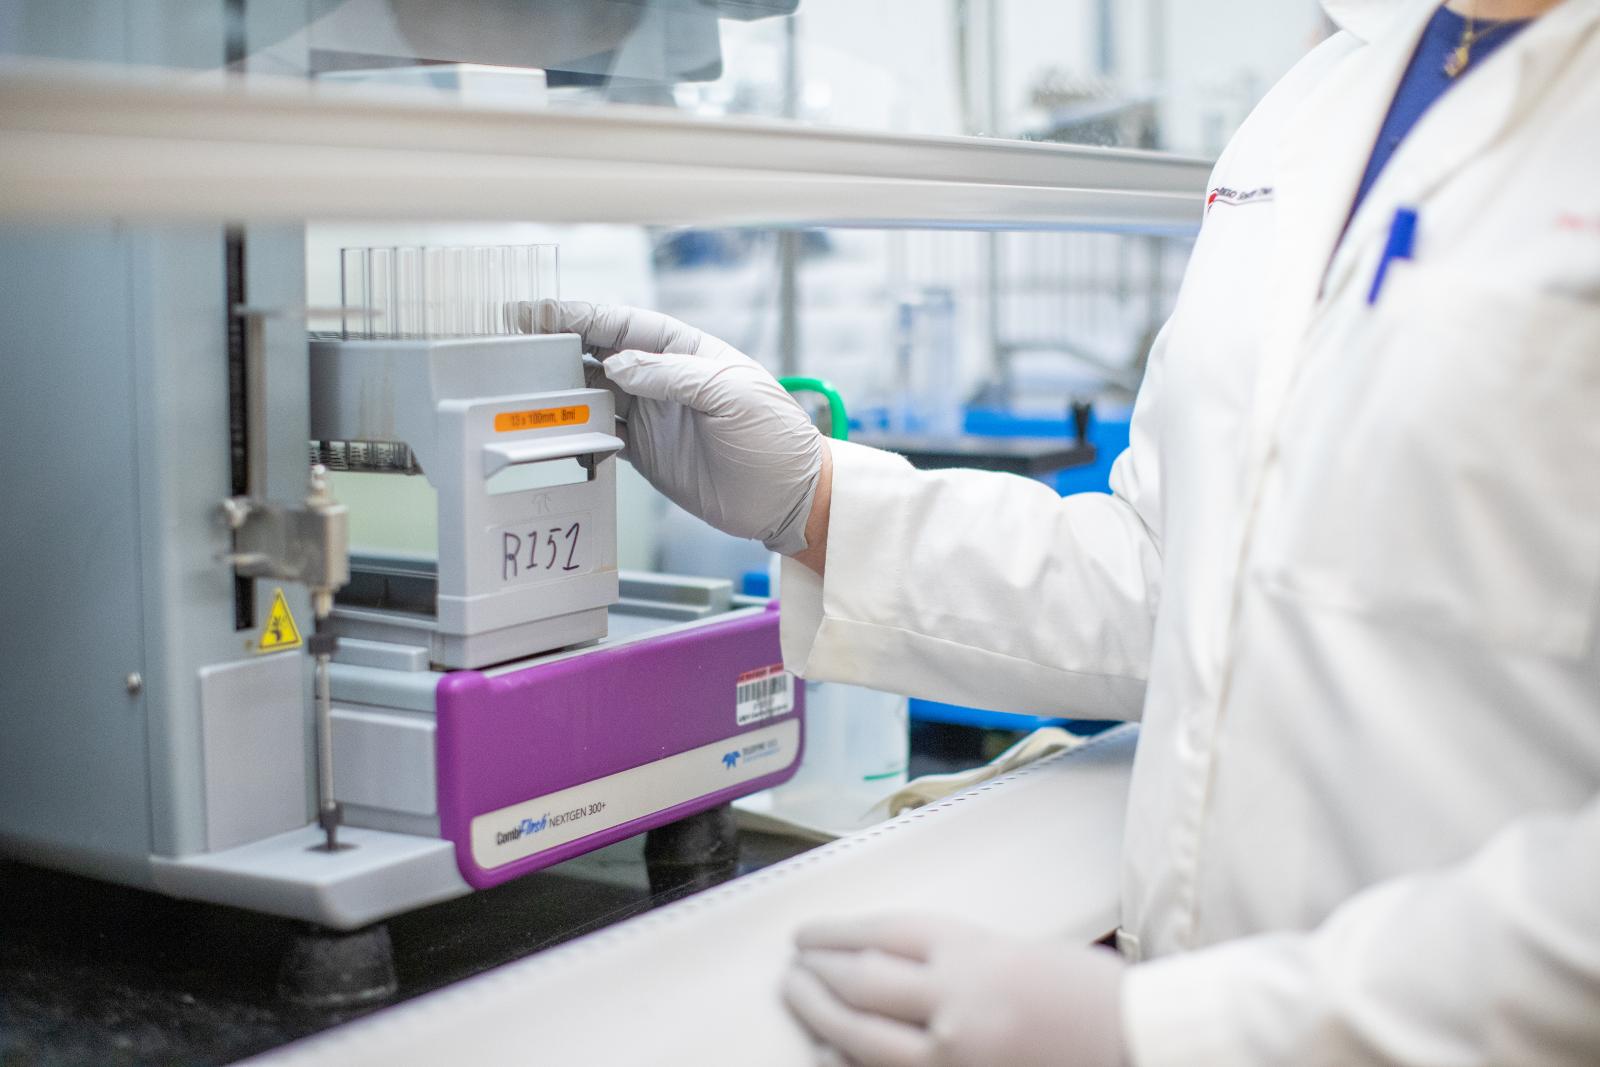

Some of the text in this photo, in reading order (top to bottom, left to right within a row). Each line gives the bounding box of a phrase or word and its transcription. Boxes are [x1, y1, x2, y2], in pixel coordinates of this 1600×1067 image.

[503, 522, 580, 581] R151
[548, 806, 588, 829] NEXTGEN
[587, 801, 607, 817] 300+
